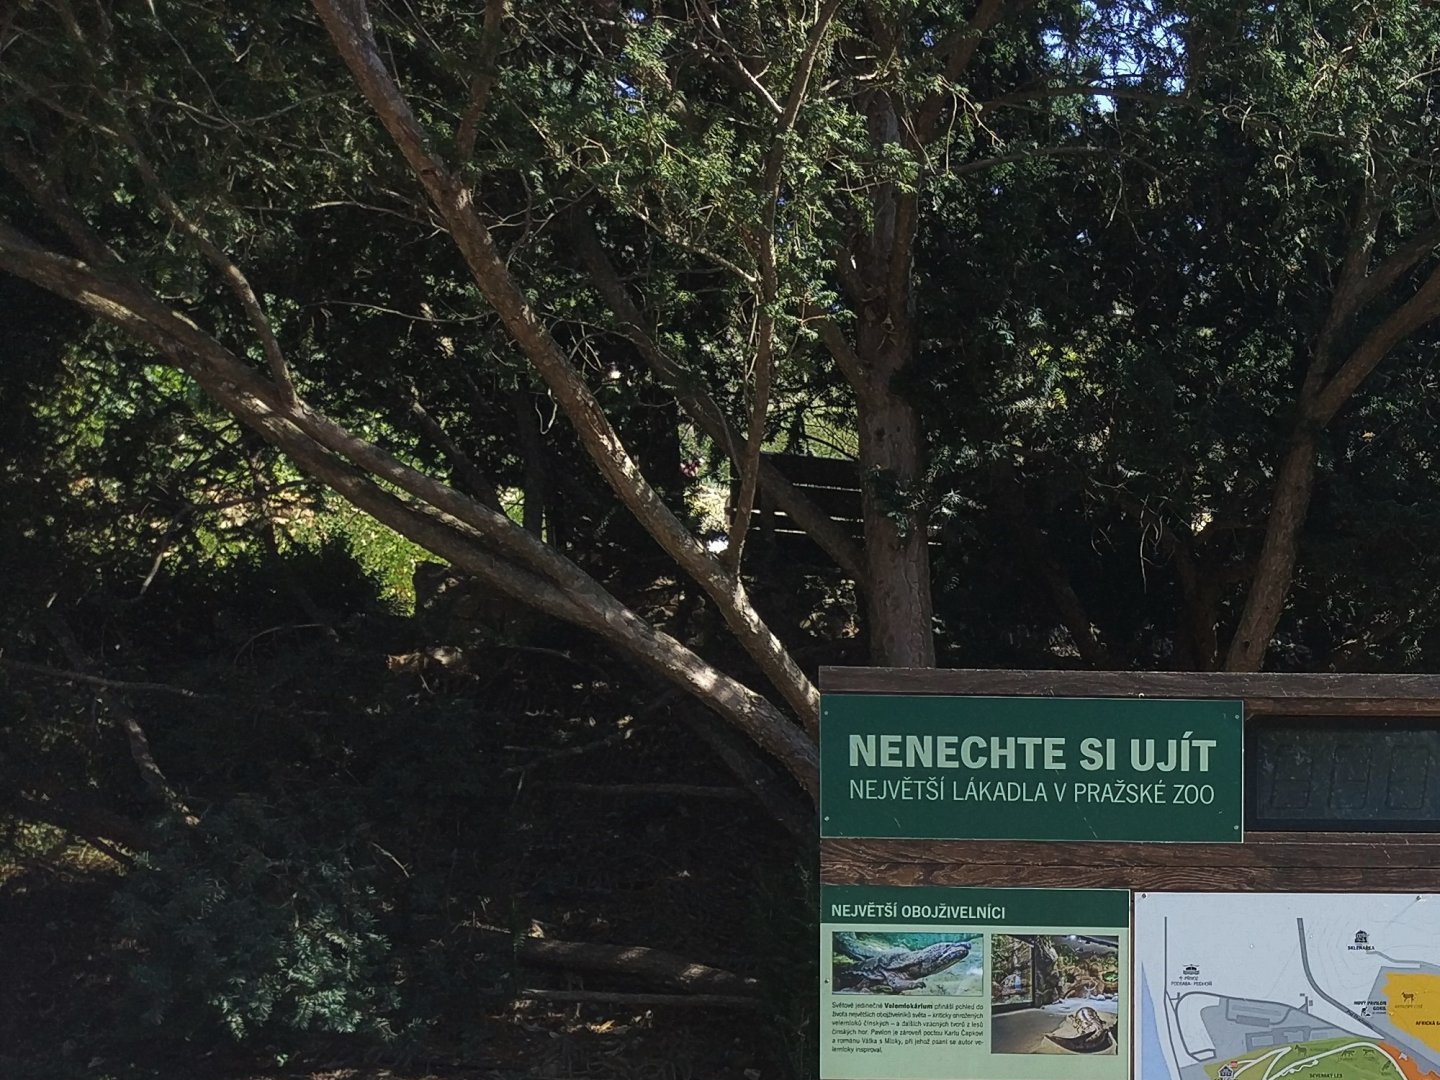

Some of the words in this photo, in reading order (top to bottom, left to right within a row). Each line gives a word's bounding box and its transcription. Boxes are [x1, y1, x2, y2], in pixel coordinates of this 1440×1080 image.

[849, 734, 1066, 770] NENECHTE
[1080, 737, 1116, 771] SI
[1130, 731, 1217, 772] UJÍT
[849, 776, 945, 801] NEJVĚTŠÍ
[953, 779, 1048, 802] LÁKADLA
[1053, 782, 1067, 802] V
[1074, 778, 1167, 804] PRAŽSKÉ
[1172, 784, 1215, 804] ZOO
[831, 902, 898, 918] NEJVĚTŠÍ
[901, 903, 1006, 920] OBOJŽIVELNÍCI
